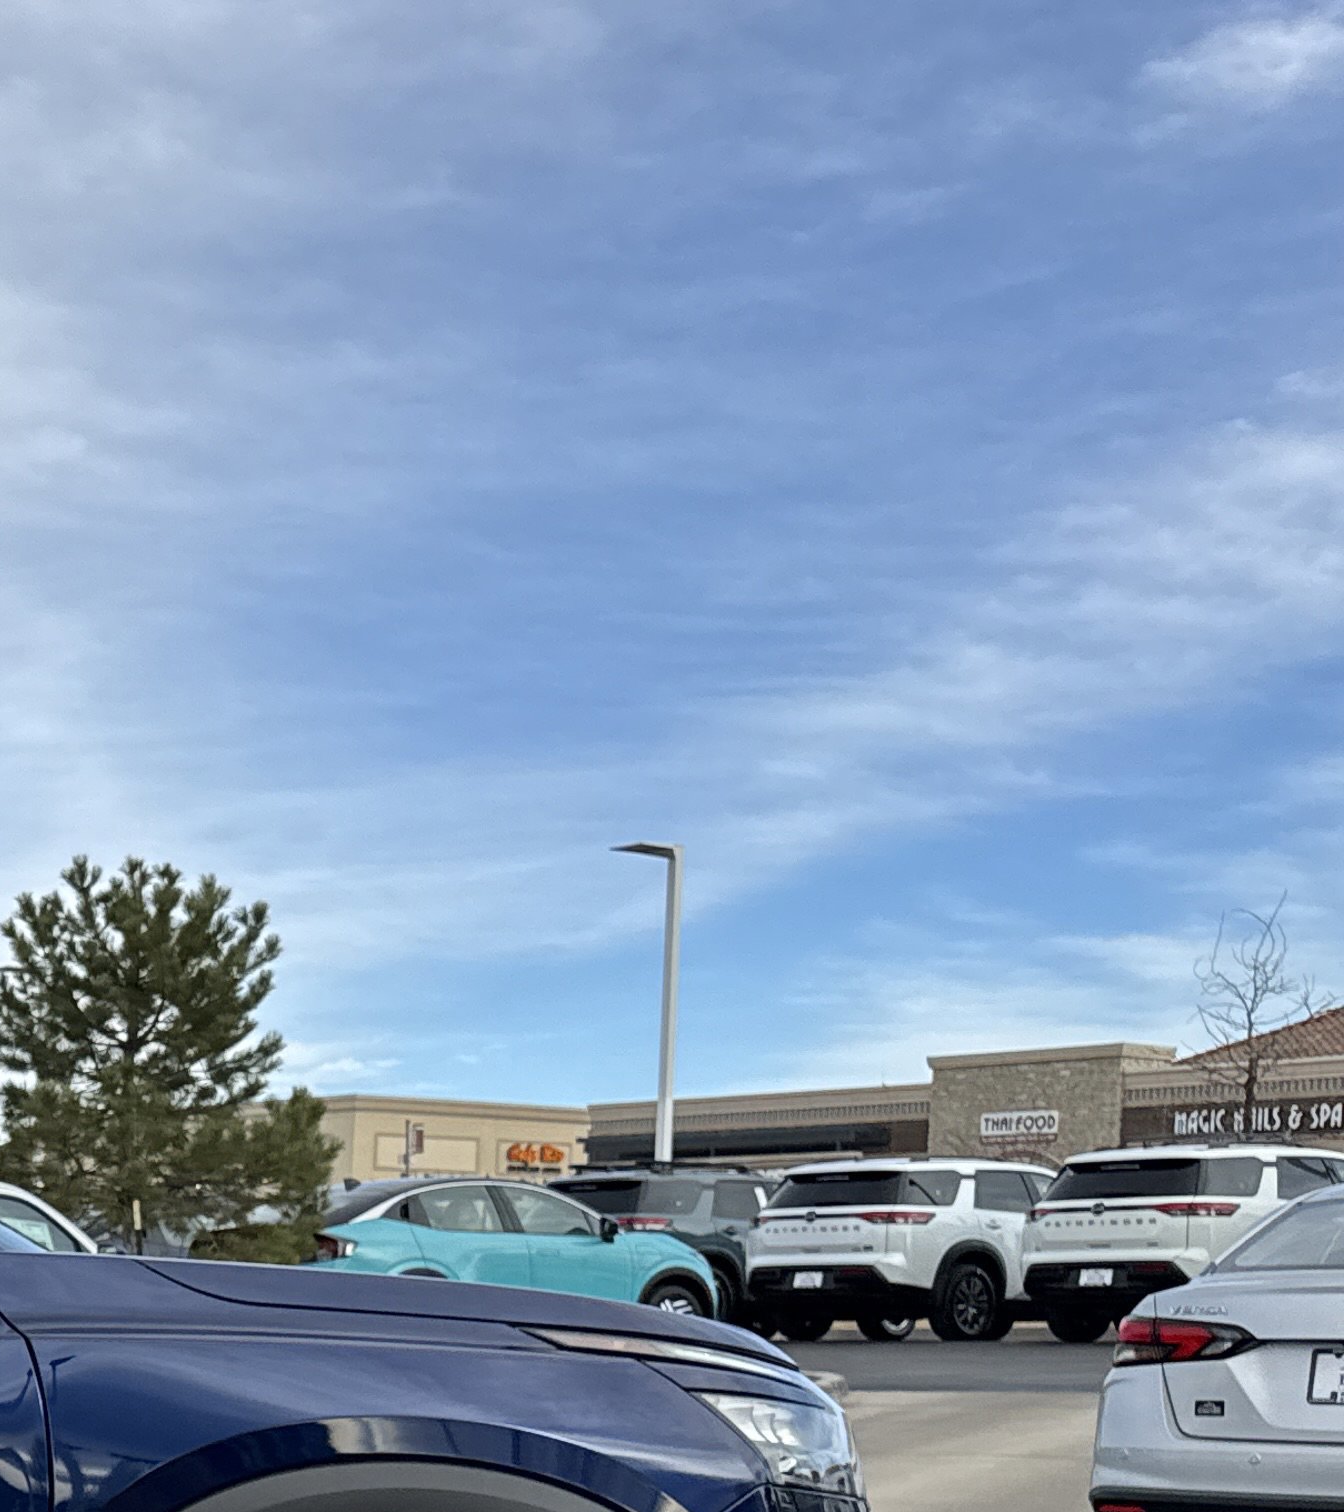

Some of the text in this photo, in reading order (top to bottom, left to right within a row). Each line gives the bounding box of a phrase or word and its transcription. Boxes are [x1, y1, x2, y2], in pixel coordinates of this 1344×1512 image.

[984, 1115, 1056, 1131] THAI FOOD
[1174, 1108, 1226, 1135] MAGIC
[1288, 1104, 1303, 1130] &
[1310, 1102, 1343, 1129] SPA
